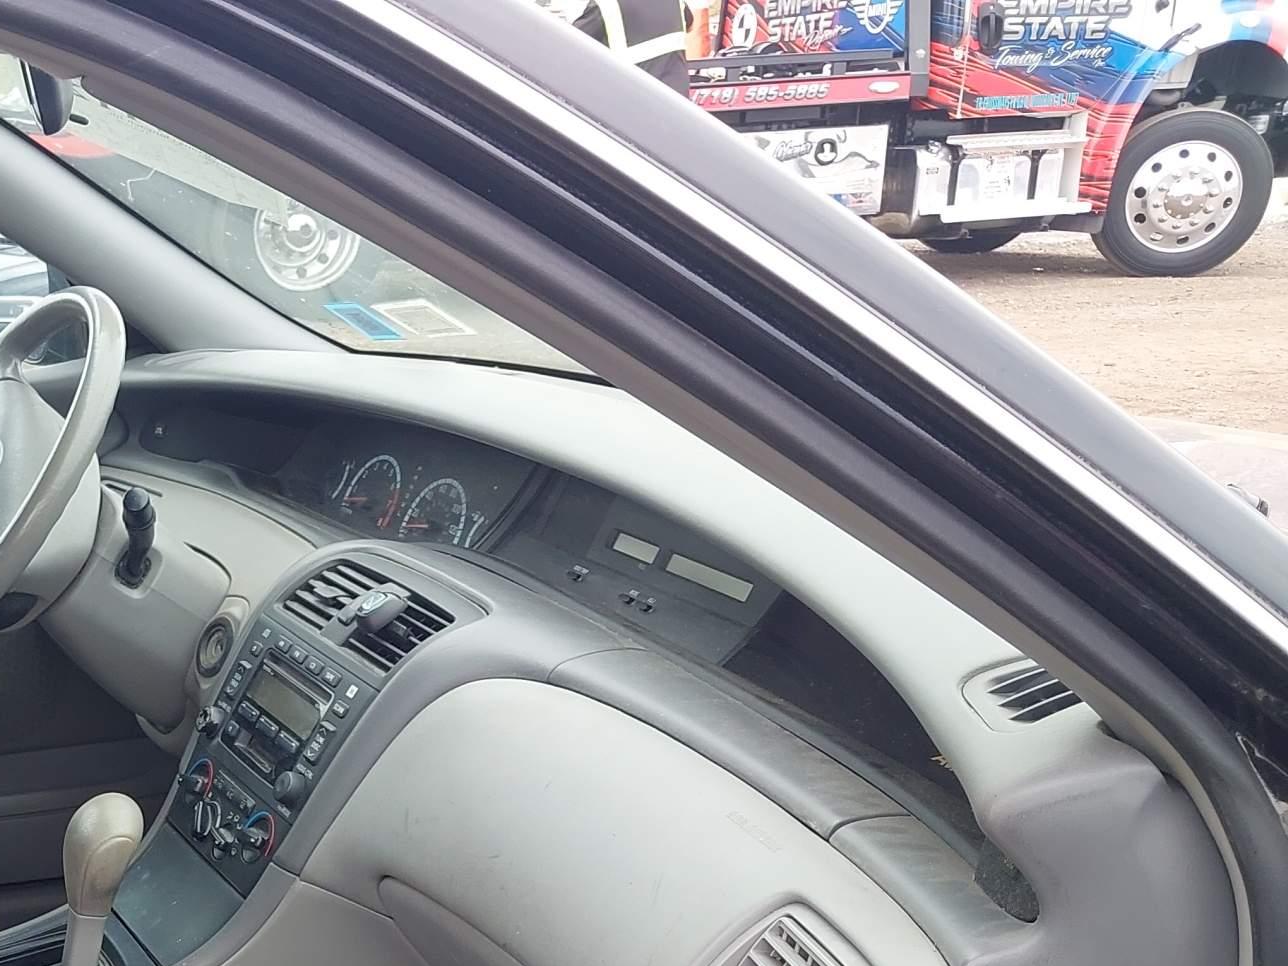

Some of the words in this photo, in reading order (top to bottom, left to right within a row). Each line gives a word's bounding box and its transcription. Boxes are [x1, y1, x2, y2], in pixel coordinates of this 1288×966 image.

[999, 0, 1132, 17] EMPIRE
[768, 12, 834, 43] STATE
[1002, 15, 1110, 41] STATE
[994, 45, 1045, 73] Towing
[1045, 47, 1055, 59] &
[1050, 41, 1112, 67] Service
[743, 83, 831, 103] 585-5885
